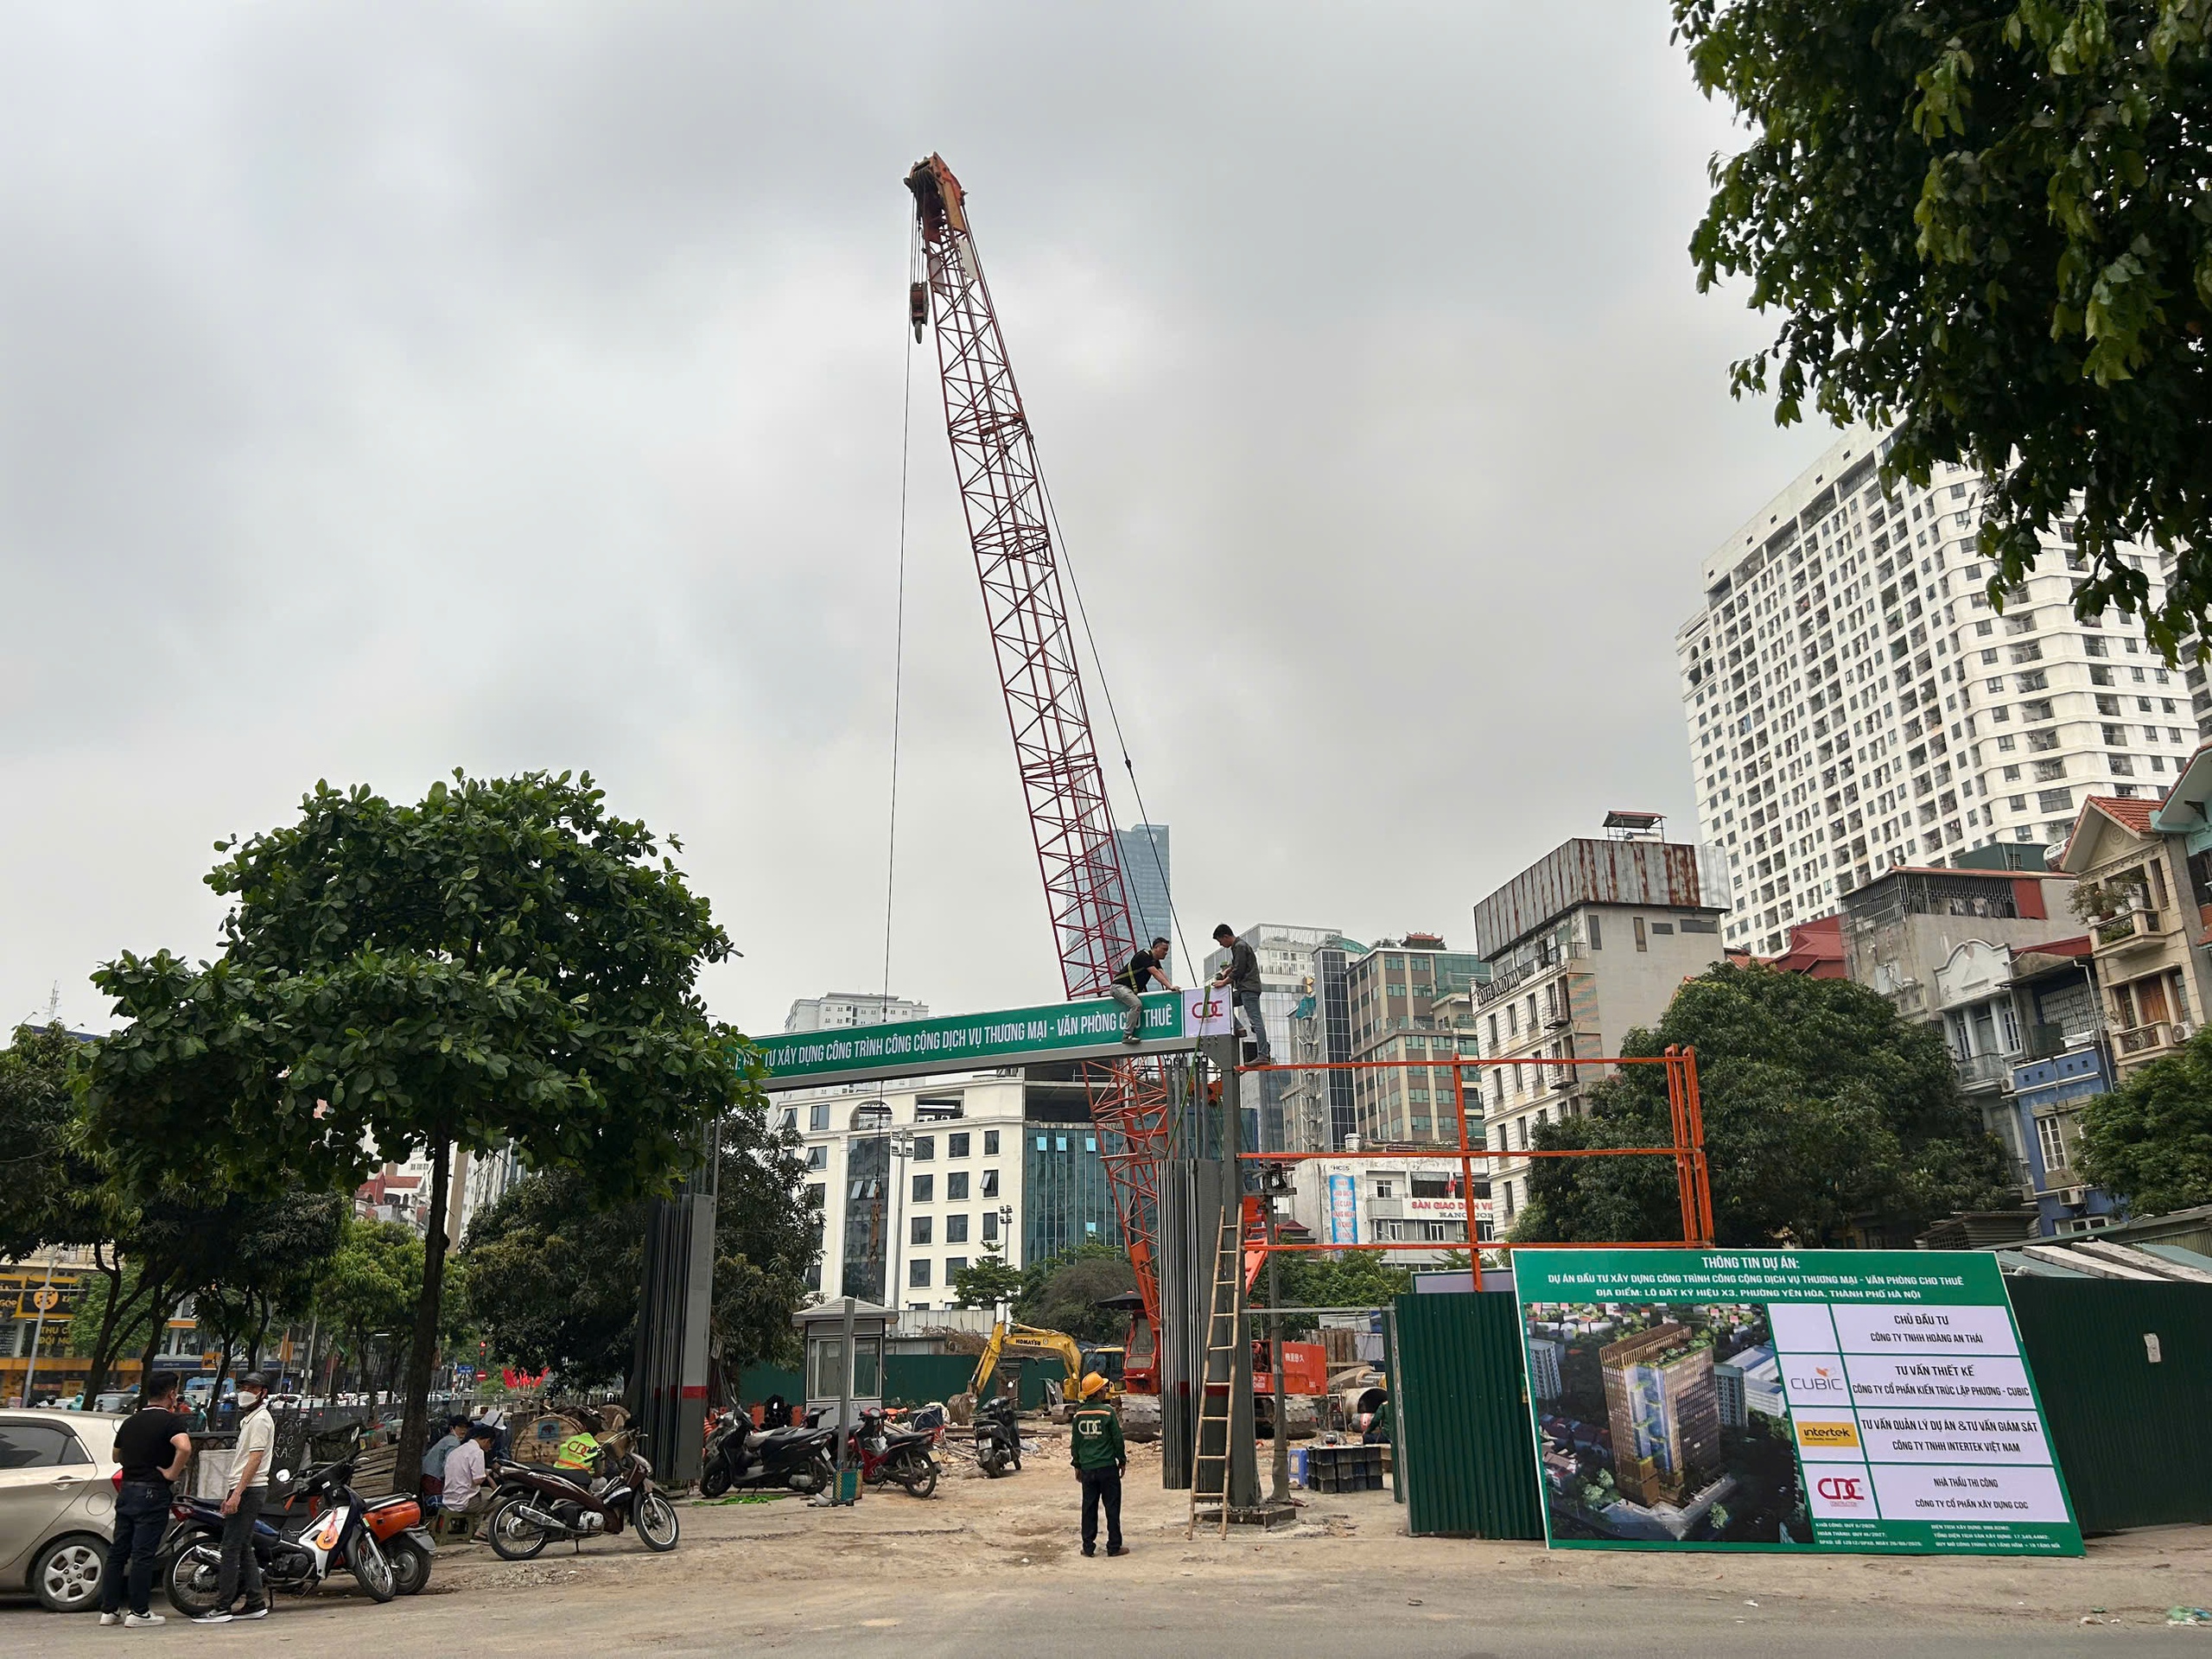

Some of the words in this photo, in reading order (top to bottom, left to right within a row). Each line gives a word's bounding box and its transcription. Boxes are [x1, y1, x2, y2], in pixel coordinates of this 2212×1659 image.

[778, 1046, 797, 1065] XÂY
[799, 1045, 823, 1066] DỰNG
[826, 1040, 851, 1060] CÔNG
[855, 1039, 882, 1058] TRÌNH
[886, 1033, 911, 1053] CÔNG
[913, 1029, 940, 1055] CỘNG
[943, 1028, 965, 1052] DỊCH
[969, 1028, 982, 1048] VỤ
[984, 1023, 1024, 1043] THƯƠNG
[1027, 1020, 1046, 1042] MẠI
[1058, 1014, 1077, 1036] VĂN
[1081, 1010, 1116, 1033] PHÒNG
[1145, 1004, 1173, 1027] THUÊ
[1412, 1199, 1431, 1209] SÀN
[1701, 1255, 1739, 1268] THÔNG
[1741, 1257, 1759, 1268] TIN
[1763, 1257, 1778, 1271] DỰ
[1781, 1255, 1800, 1268] ÁN:
[1548, 1274, 1560, 1284] DỰ
[1562, 1273, 1575, 1282] ÁN
[1577, 1273, 1595, 1282] ĐẦU
[1611, 1273, 1629, 1282] XÂY
[1631, 1274, 1655, 1284] DỰNG
[1657, 1273, 1681, 1283] CÔNG
[1684, 1274, 1710, 1282] TRÌNH
[1713, 1273, 1737, 1283] CÔNG
[1738, 1274, 1762, 1285] CỘNG
[1764, 1275, 1785, 1285] DỊCH
[1788, 1275, 1800, 1285] VỤ
[1802, 1275, 1838, 1284] THƯƠNG
[1840, 1275, 1857, 1286] MẠI
[1866, 1275, 1885, 1284] VĂN
[1886, 1275, 1917, 1285] PHÒNG
[1939, 1275, 1964, 1286] THUÊ
[1660, 1287, 1679, 1296] ĐẤT
[1696, 1288, 1719, 1297] HIỆU
[1828, 1289, 1863, 1298] THÀNH
[1866, 1289, 1885, 1298] PHỐ
[1887, 1289, 1902, 1299] HÀ
[1904, 1290, 1921, 1300] NỘI
[1894, 1313, 1913, 1325] CHỦ
[1915, 1313, 1934, 1325] ĐẦU
[1871, 1332, 1891, 1342] CÔNG
[1926, 1332, 1952, 1343] HOÀNG
[1966, 1332, 1983, 1343] THÁI
[1895, 1366, 1909, 1376] TƯ
[1910, 1363, 1929, 1376] VẤN
[1931, 1364, 1959, 1376] THIẾT
[1961, 1364, 1974, 1376] KẾ
[1790, 1377, 1843, 1390] CUBIC
[1853, 1382, 1872, 1394] CÔNG
[1873, 1385, 1883, 1394] TY
[1885, 1382, 1894, 1394] CỔ
[1895, 1382, 1916, 1395] PHẦN
[1917, 1383, 1935, 1395] KIẾN
[1936, 1383, 1954, 1395] TRÚC
[1955, 1384, 1970, 1397] LẬP
[1972, 1385, 2001, 1395] PHƯƠNG
[2007, 1387, 2030, 1396] CUBIC
[1078, 1420, 1103, 1434] CDC
[1873, 1417, 1892, 1429] VẤN
[1893, 1418, 1916, 1430] QUẢN
[1918, 1419, 1929, 1430] LÝ
[1930, 1421, 1942, 1432] DỰ
[1944, 1419, 1956, 1430] ÁN
[1979, 1418, 1996, 1431] VẤN
[1998, 1420, 2019, 1432] GIÁM
[2021, 1420, 2037, 1432] SÁT
[1803, 1427, 1850, 1436] intertek
[1892, 1439, 1914, 1451] CÔNG
[1915, 1441, 1923, 1451] TY
[1925, 1441, 1945, 1451] TNHH
[1947, 1442, 1983, 1452] INTERTEK
[1985, 1440, 2001, 1453] VIỆT
[2003, 1443, 2020, 1452] NAM
[1817, 1478, 1865, 1500] CDC
[1934, 1477, 1948, 1487] NHÀ
[1949, 1477, 1967, 1487] THẦU
[1980, 1478, 1998, 1488] CÔNG
[1916, 1498, 1934, 1508] CÔNG
[1946, 1497, 1956, 1508] CỔ
[1958, 1499, 1976, 1509] PHẦN
[1978, 1499, 1992, 1509] XÂY
[1993, 1500, 2014, 1510] DỰNG
